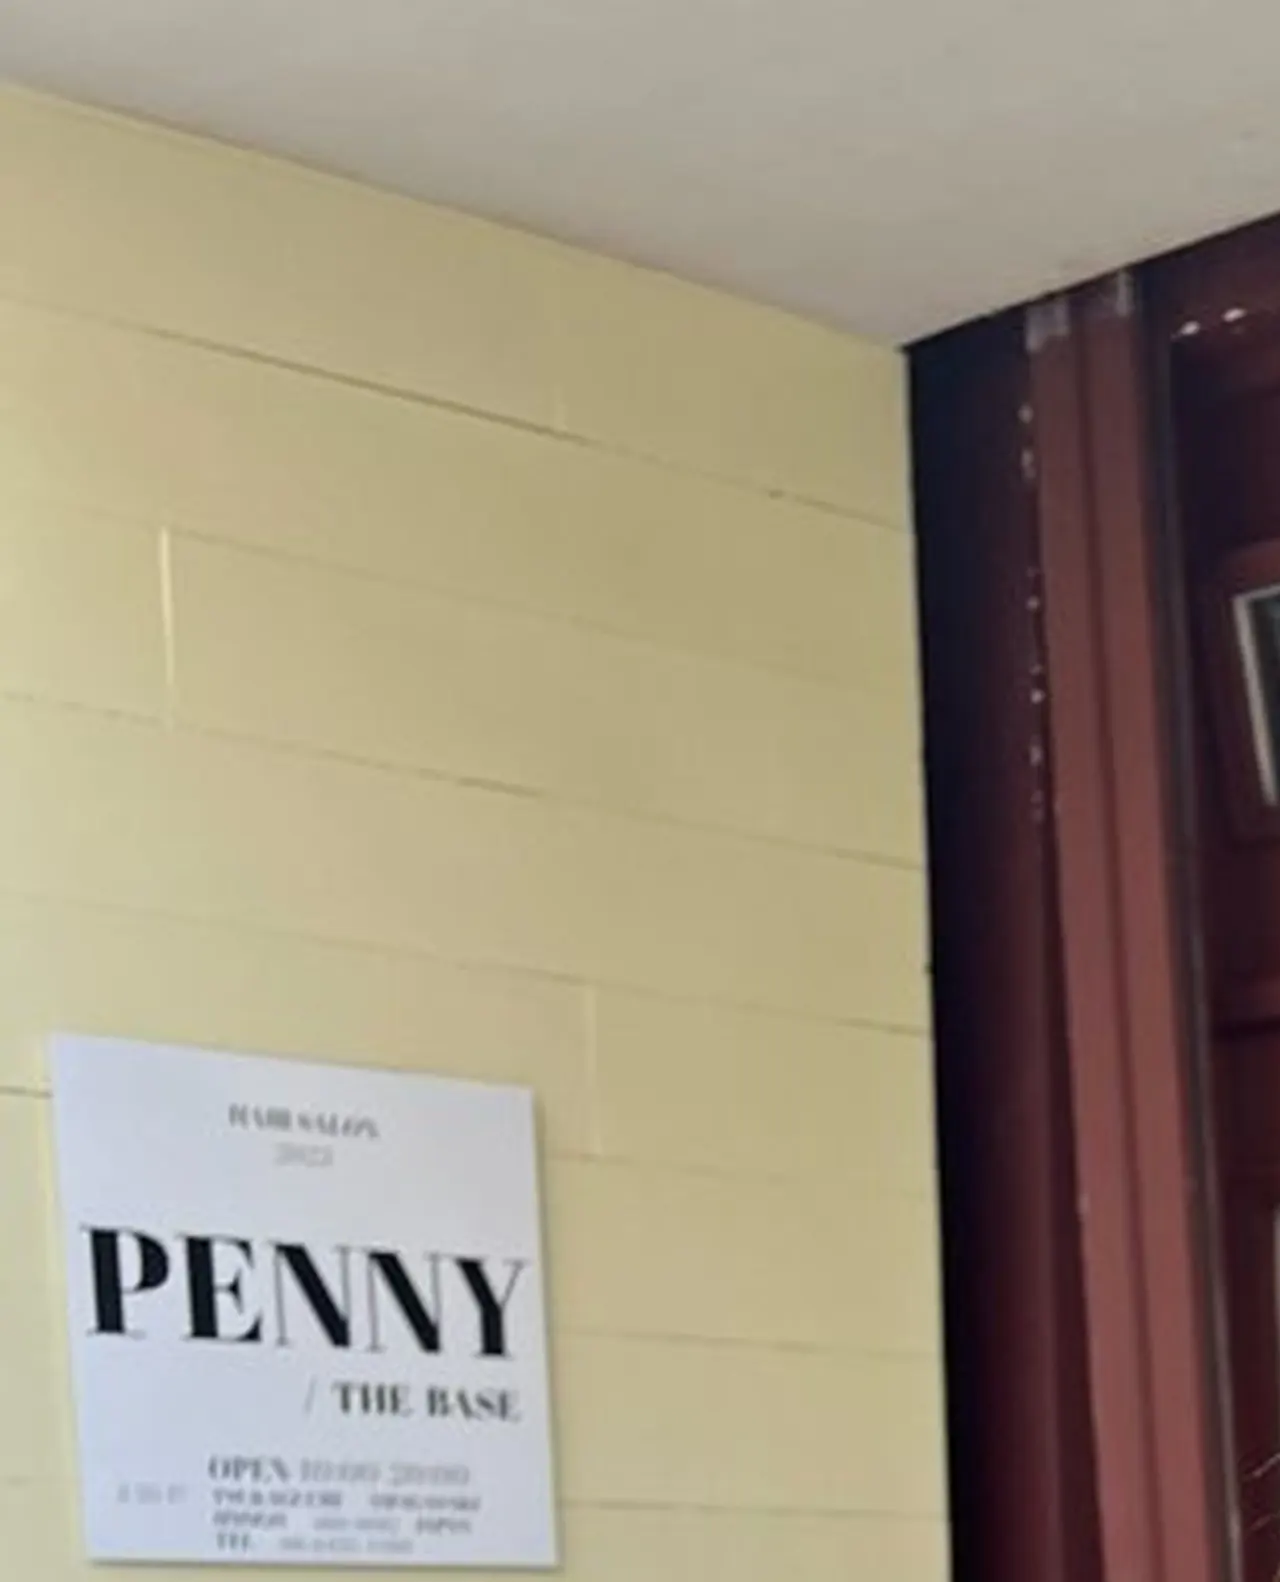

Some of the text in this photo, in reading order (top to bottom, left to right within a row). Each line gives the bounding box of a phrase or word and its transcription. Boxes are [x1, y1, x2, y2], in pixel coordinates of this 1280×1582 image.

[80, 1223, 531, 1360] PENNY
[332, 1380, 412, 1416] THE
[426, 1384, 521, 1422] BASE
[207, 1455, 290, 1483] OPEN
